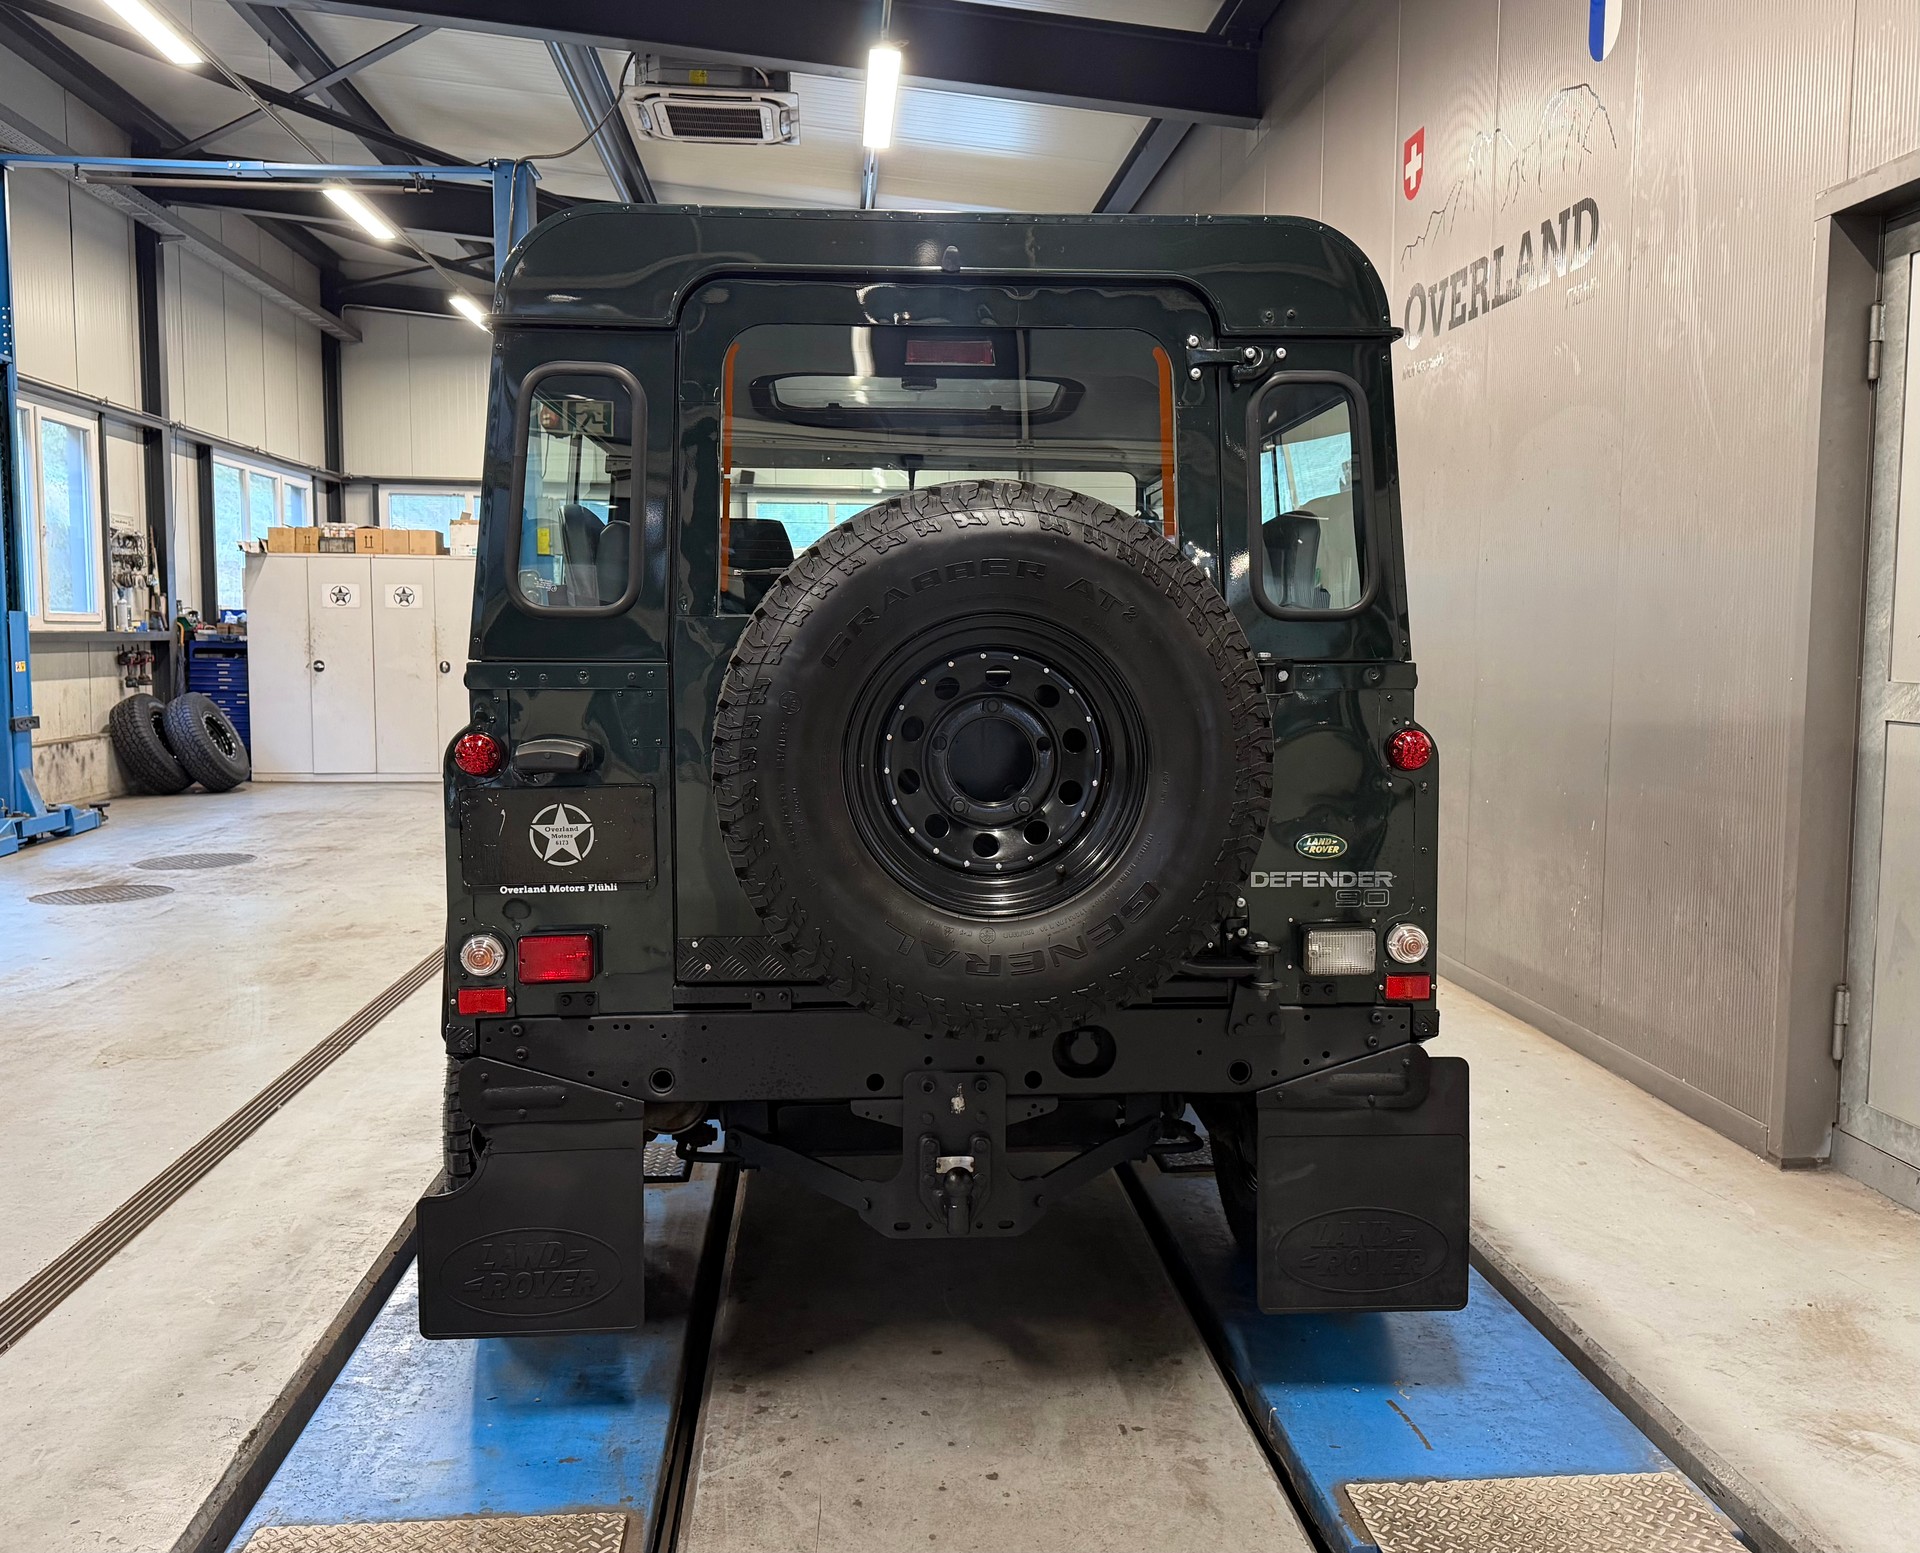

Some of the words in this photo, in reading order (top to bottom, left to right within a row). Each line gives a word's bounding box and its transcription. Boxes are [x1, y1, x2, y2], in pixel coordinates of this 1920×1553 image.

[1404, 197, 1600, 351] OVERLAND
[820, 557, 1050, 670] GRABBER
[1306, 837, 1332, 846] LAND
[1308, 845, 1340, 854] ROVER
[499, 884, 547, 894] Overland
[549, 884, 585, 893] Motors
[588, 882, 618, 892] Flühli
[1250, 871, 1394, 888] DEFENDER
[1335, 889, 1390, 908] 90
[885, 880, 1162, 977] GENERAL
[1310, 1221, 1393, 1249] LAND
[474, 1241, 566, 1271] LAND
[1317, 1248, 1427, 1277] ROVER
[481, 1269, 600, 1301] ROVER
